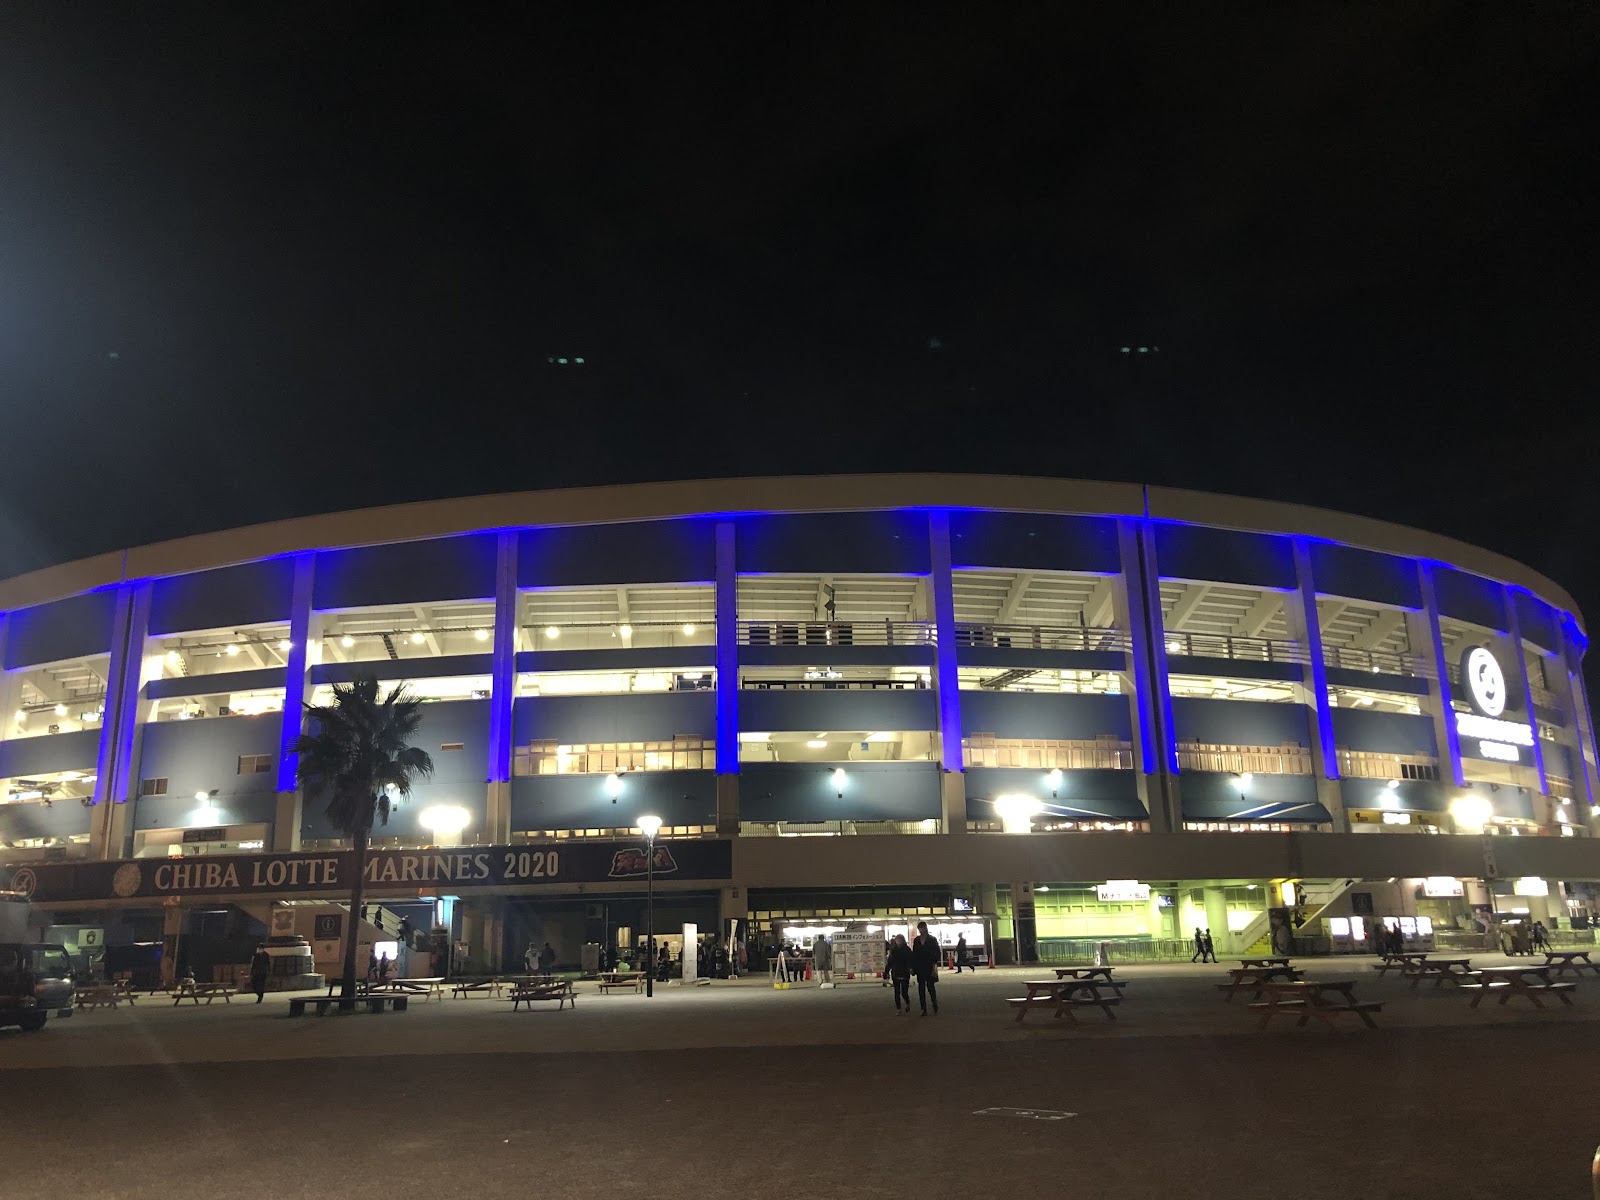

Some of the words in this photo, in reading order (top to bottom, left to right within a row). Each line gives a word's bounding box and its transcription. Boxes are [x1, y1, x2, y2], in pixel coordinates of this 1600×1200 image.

[154, 862, 240, 890] CHIBA
[252, 858, 339, 886] LOTTE
[362, 853, 490, 882] MARINES
[503, 851, 559, 879] 2020
